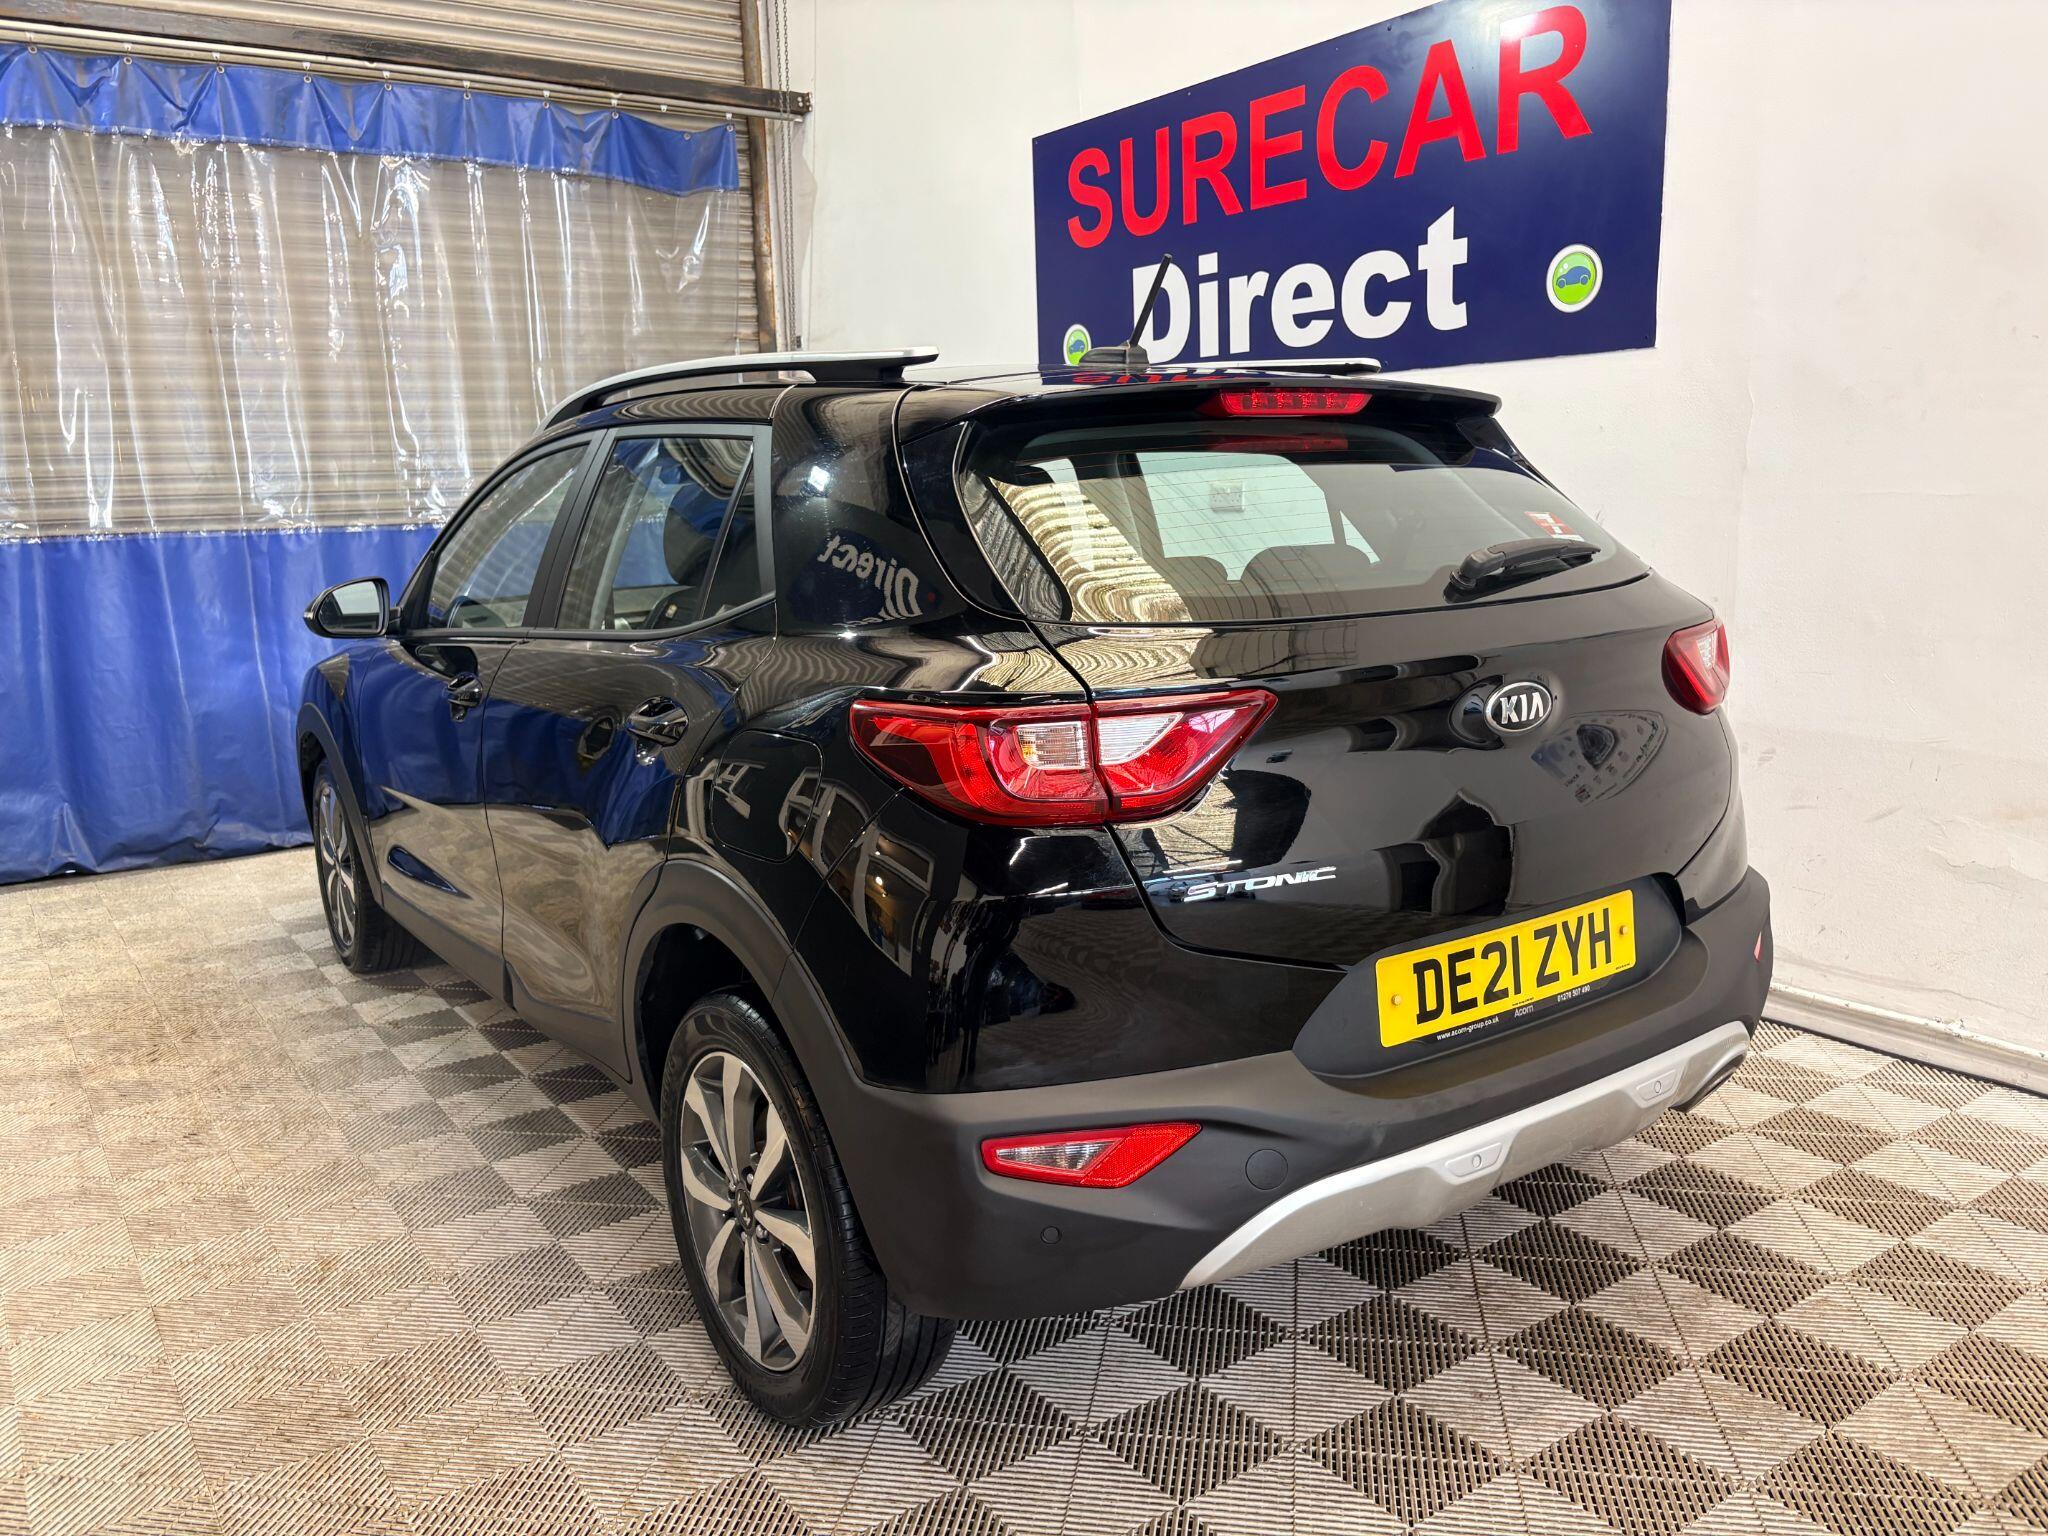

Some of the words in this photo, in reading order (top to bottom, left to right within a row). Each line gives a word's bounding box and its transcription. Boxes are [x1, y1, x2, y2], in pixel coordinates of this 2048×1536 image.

[1067, 5, 1593, 248] SURECAR
[1132, 205, 1469, 364] Direct
[1500, 691, 1544, 725] KIA
[1184, 866, 1337, 902] STONIC
[1412, 934, 1521, 1025] DE21
[1533, 908, 1612, 988] ZYH
